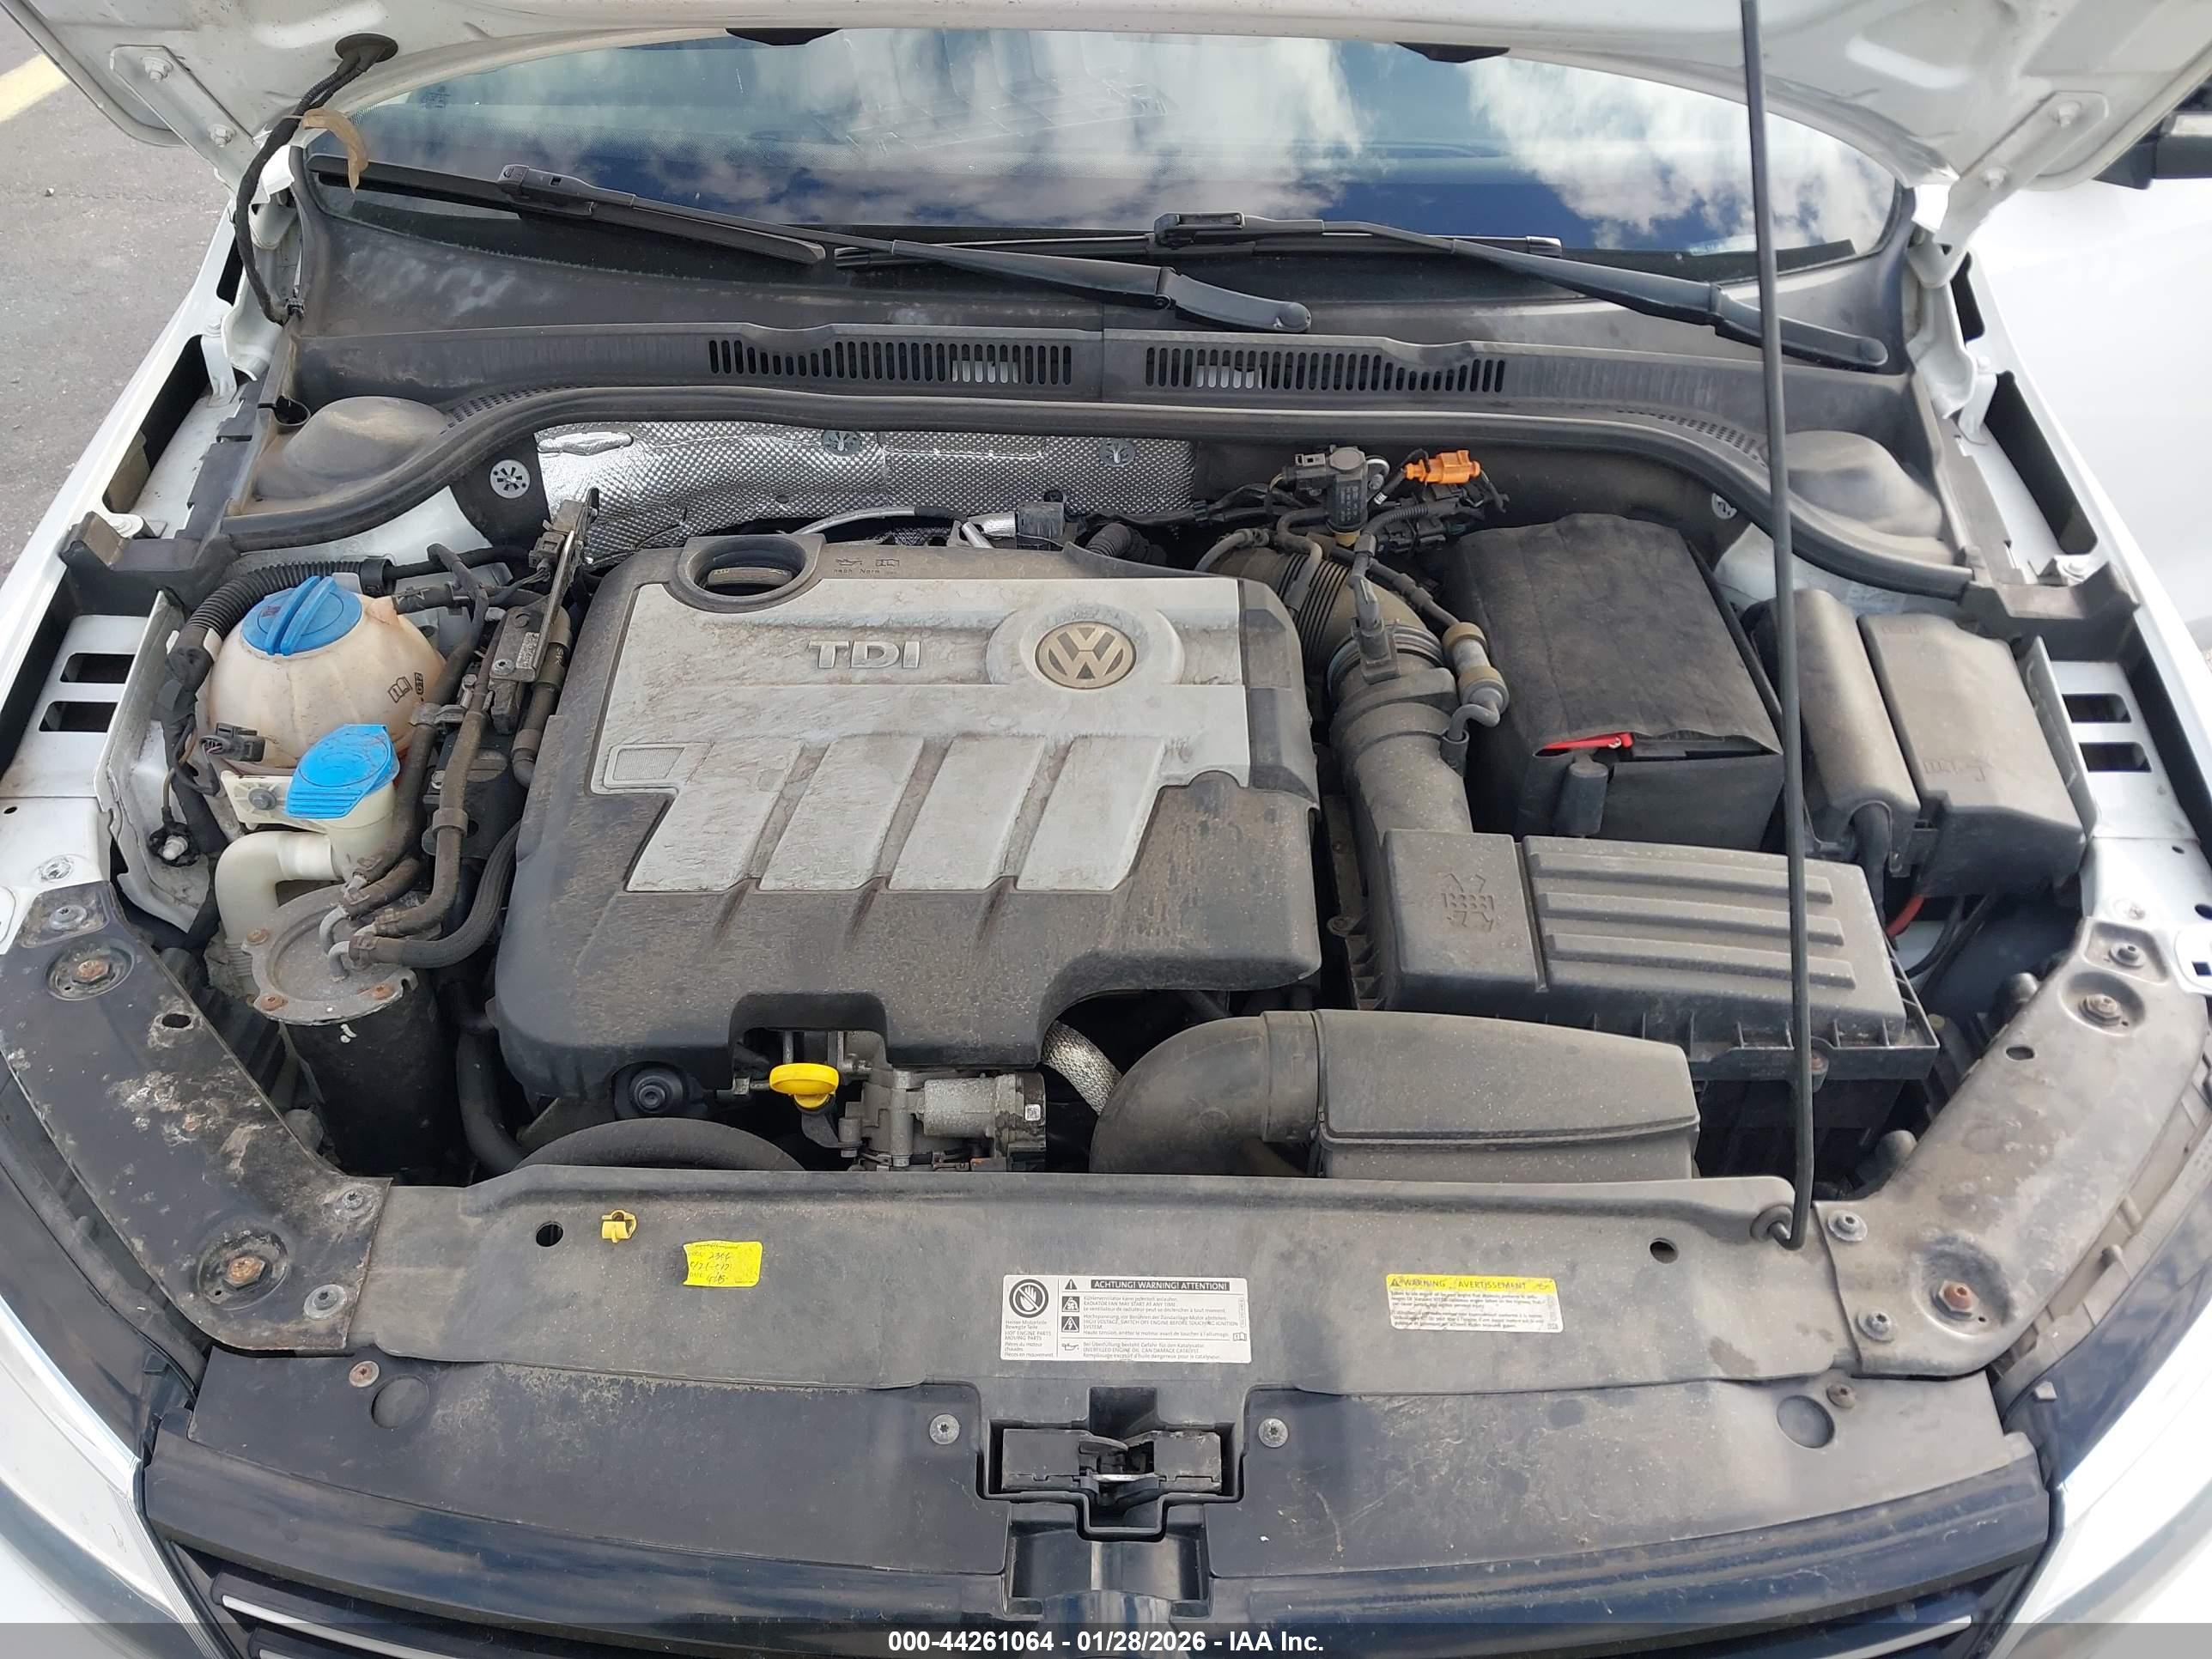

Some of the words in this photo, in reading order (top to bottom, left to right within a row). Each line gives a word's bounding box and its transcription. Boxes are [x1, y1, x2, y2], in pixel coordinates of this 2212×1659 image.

[808, 640, 921, 669] TDI
[1403, 1278, 1446, 1287] WARNING
[1457, 1279, 1526, 1289] AVERTISSEMENT
